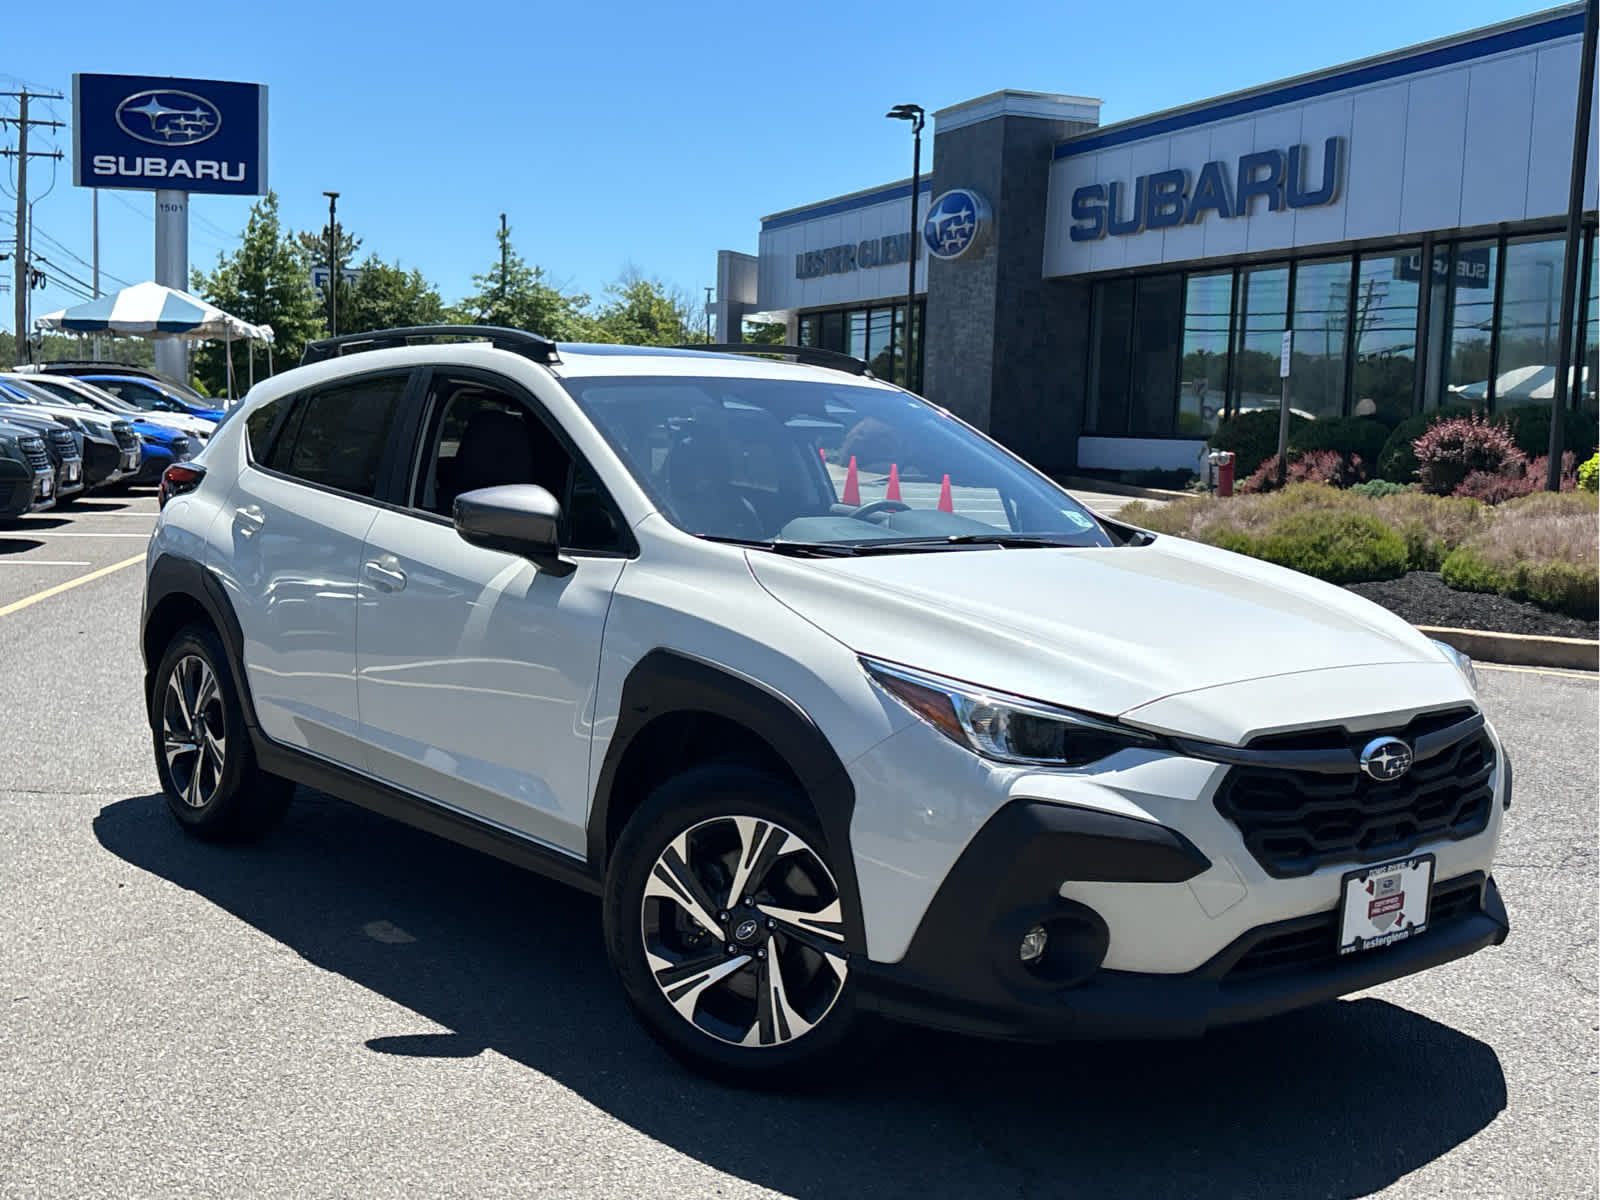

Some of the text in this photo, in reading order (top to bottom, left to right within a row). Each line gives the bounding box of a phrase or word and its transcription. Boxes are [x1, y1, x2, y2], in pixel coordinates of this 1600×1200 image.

[93, 155, 246, 182] SUBARU
[1070, 136, 1343, 242] SUBARU
[159, 203, 184, 213] 1501
[795, 243, 858, 280] LESTER
